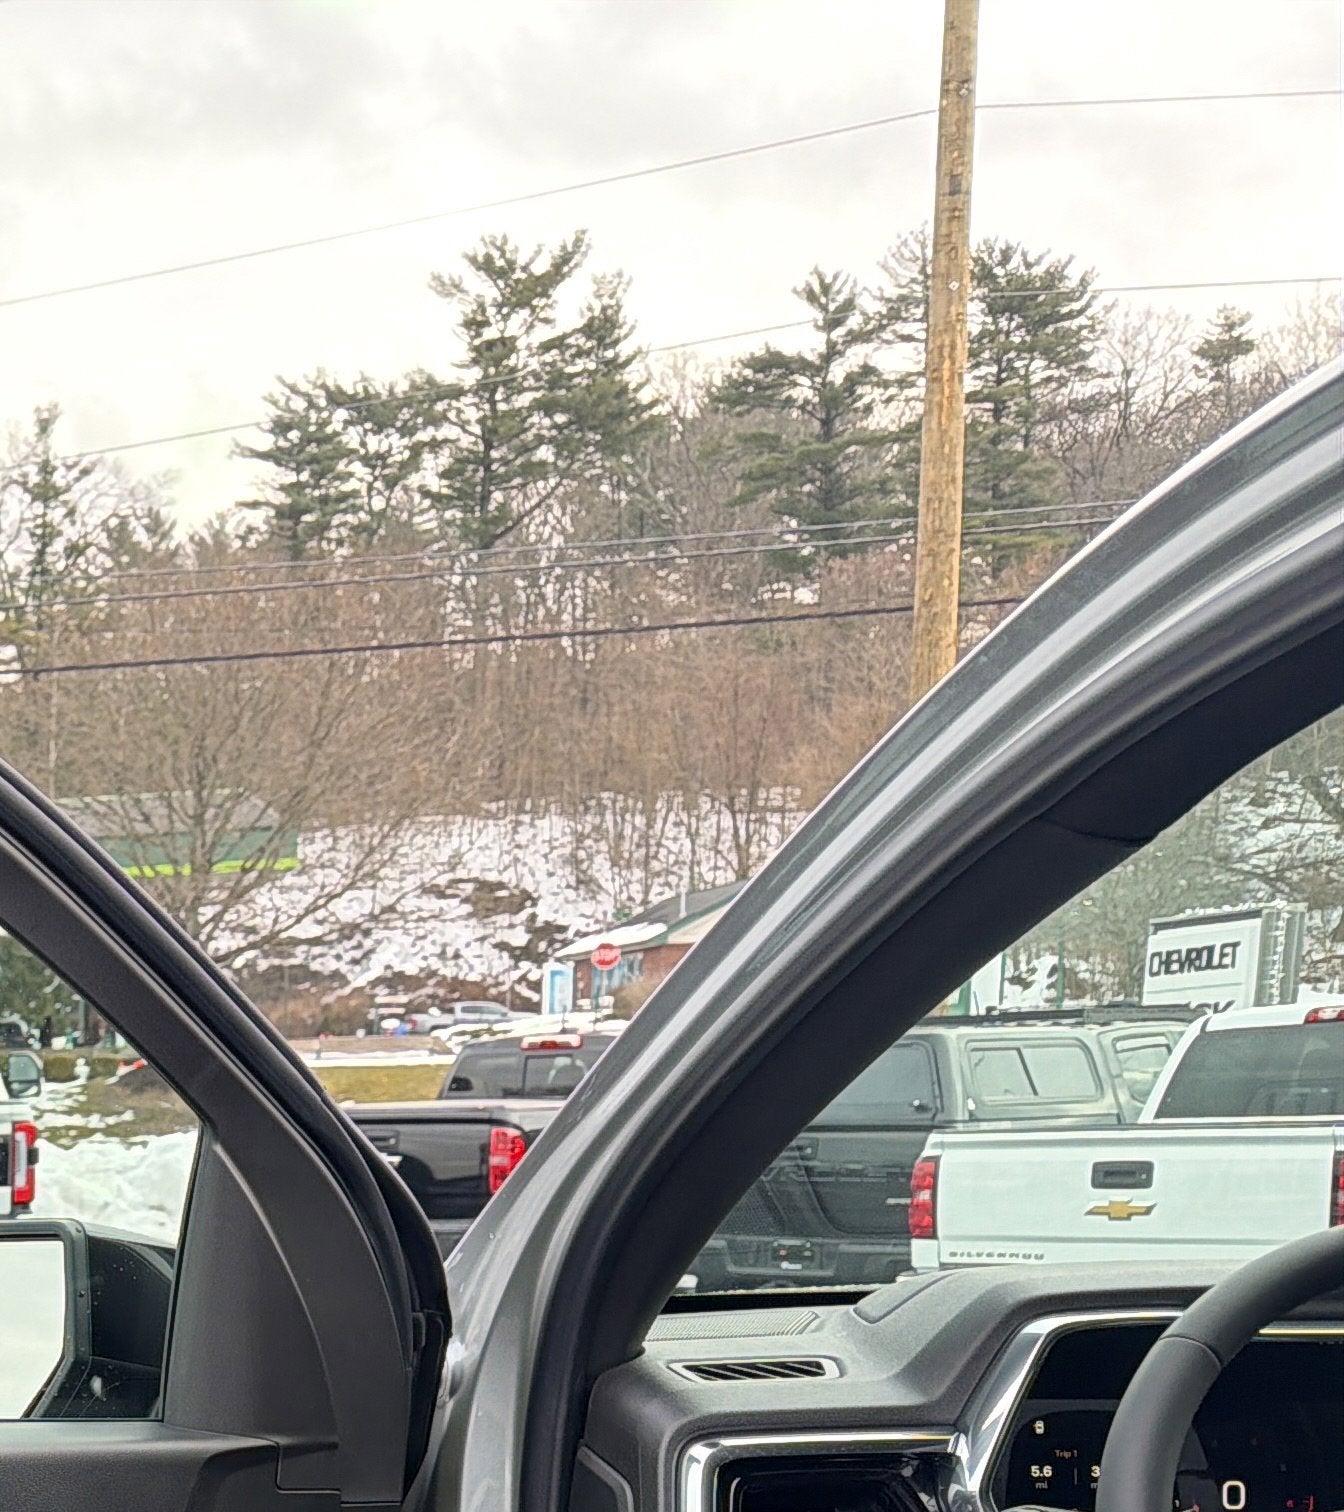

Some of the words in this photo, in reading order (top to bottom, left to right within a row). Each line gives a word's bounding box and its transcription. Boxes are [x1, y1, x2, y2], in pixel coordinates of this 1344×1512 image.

[1148, 940, 1242, 978] CHEVROLET
[1054, 1449, 1072, 1459] Trip
[1030, 1465, 1053, 1477] 5.6
[1035, 1481, 1048, 1489] mi
[1222, 1480, 1246, 1511] 0
